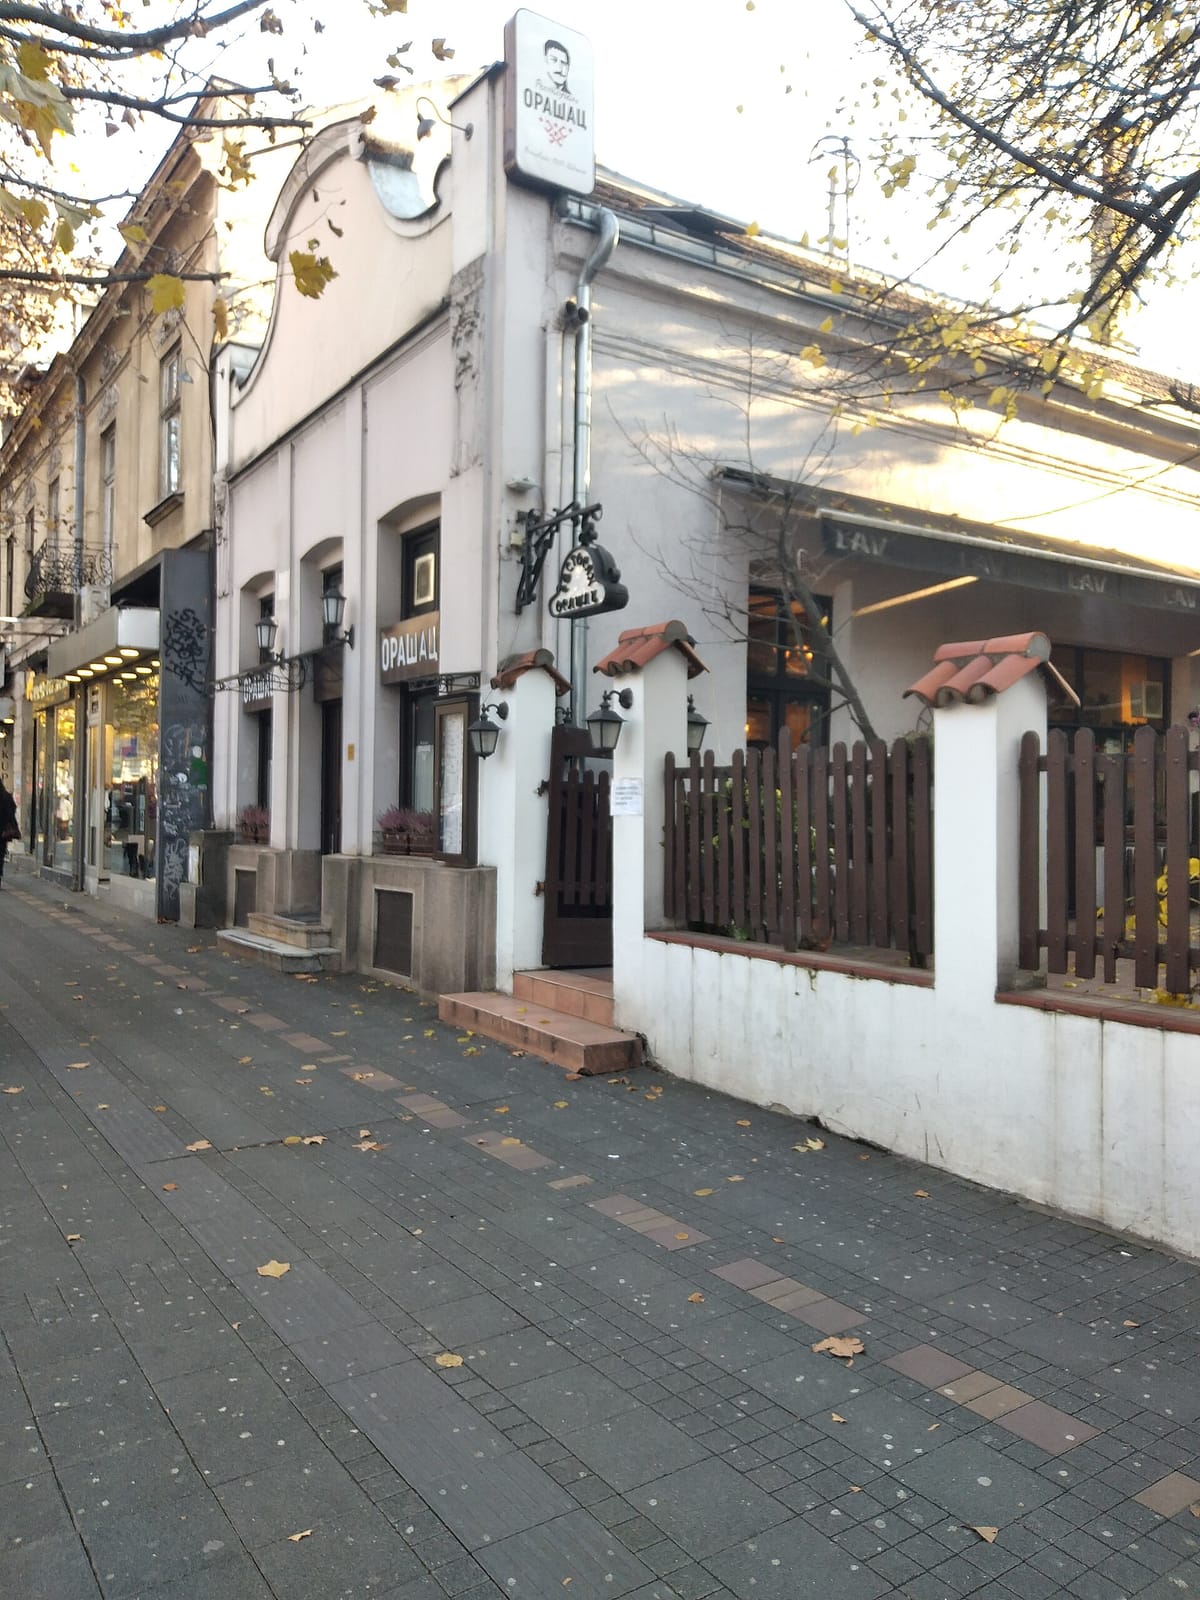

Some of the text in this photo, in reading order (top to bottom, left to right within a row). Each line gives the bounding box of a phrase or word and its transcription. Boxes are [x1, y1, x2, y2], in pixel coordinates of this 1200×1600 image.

[524, 88, 587, 131] ОРАШАЦ
[835, 528, 887, 556] LAV
[1068, 572, 1108, 593] LAV
[381, 624, 439, 672] ОРАШАЦ
